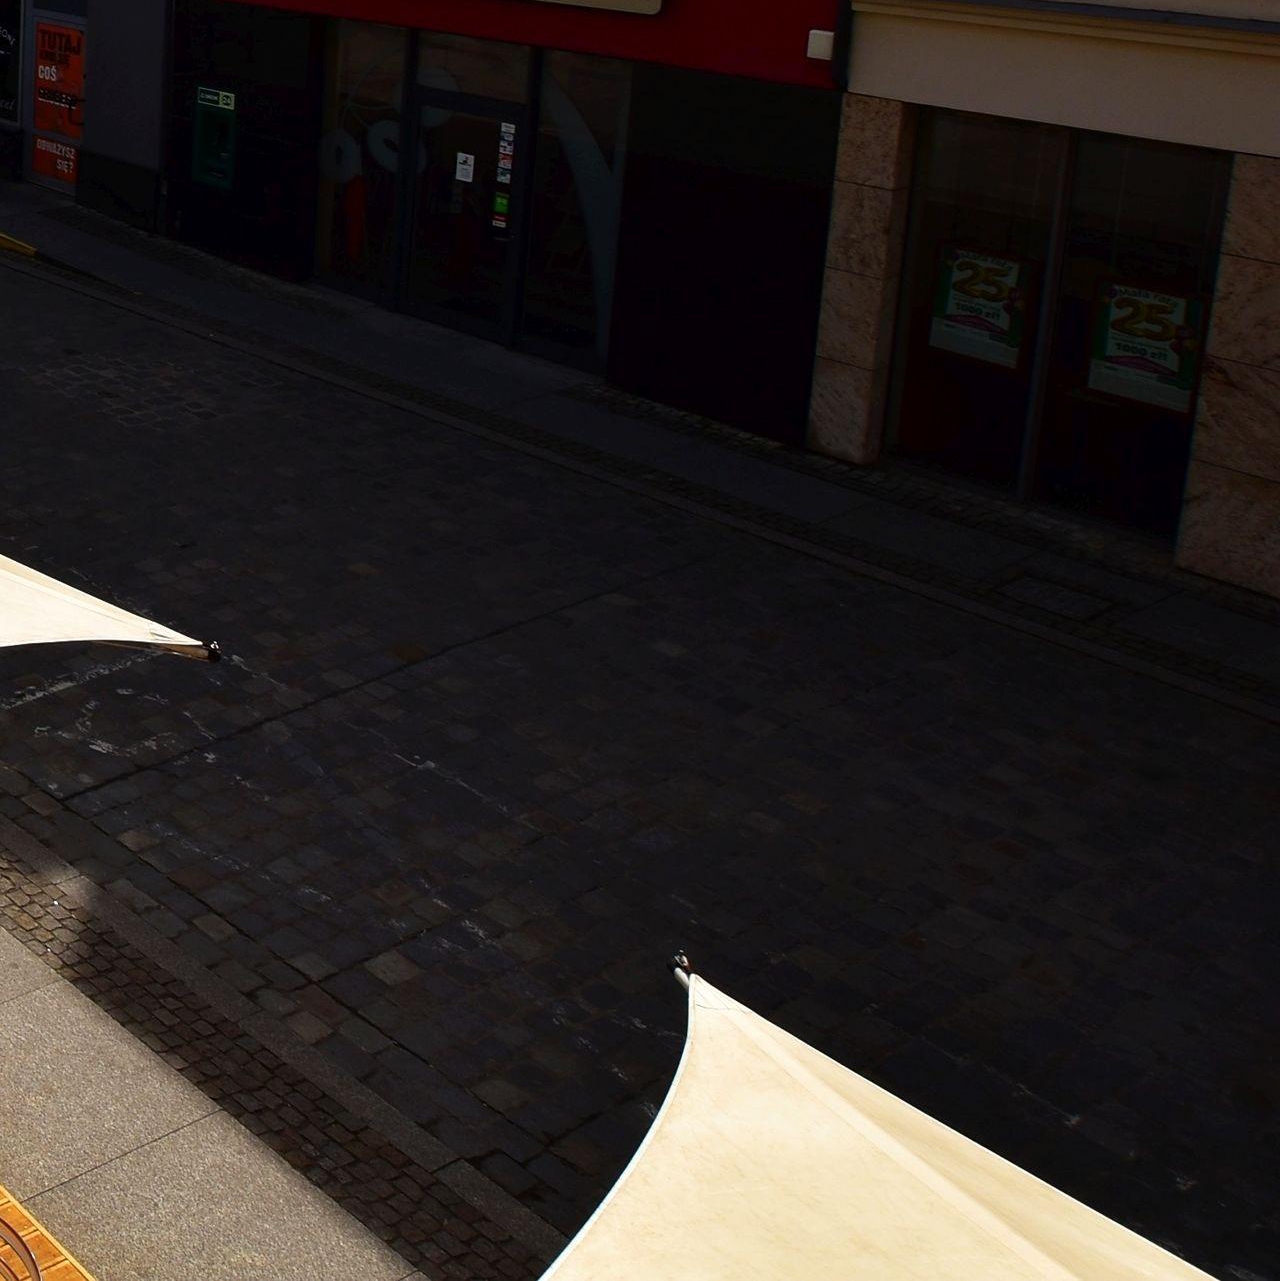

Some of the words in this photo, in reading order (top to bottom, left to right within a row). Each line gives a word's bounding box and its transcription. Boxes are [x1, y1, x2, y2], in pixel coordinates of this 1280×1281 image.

[39, 29, 81, 55] TUTAJ
[952, 260, 1010, 302] 25
[1110, 297, 1178, 341] 25
[1115, 342, 1148, 355] 1000
